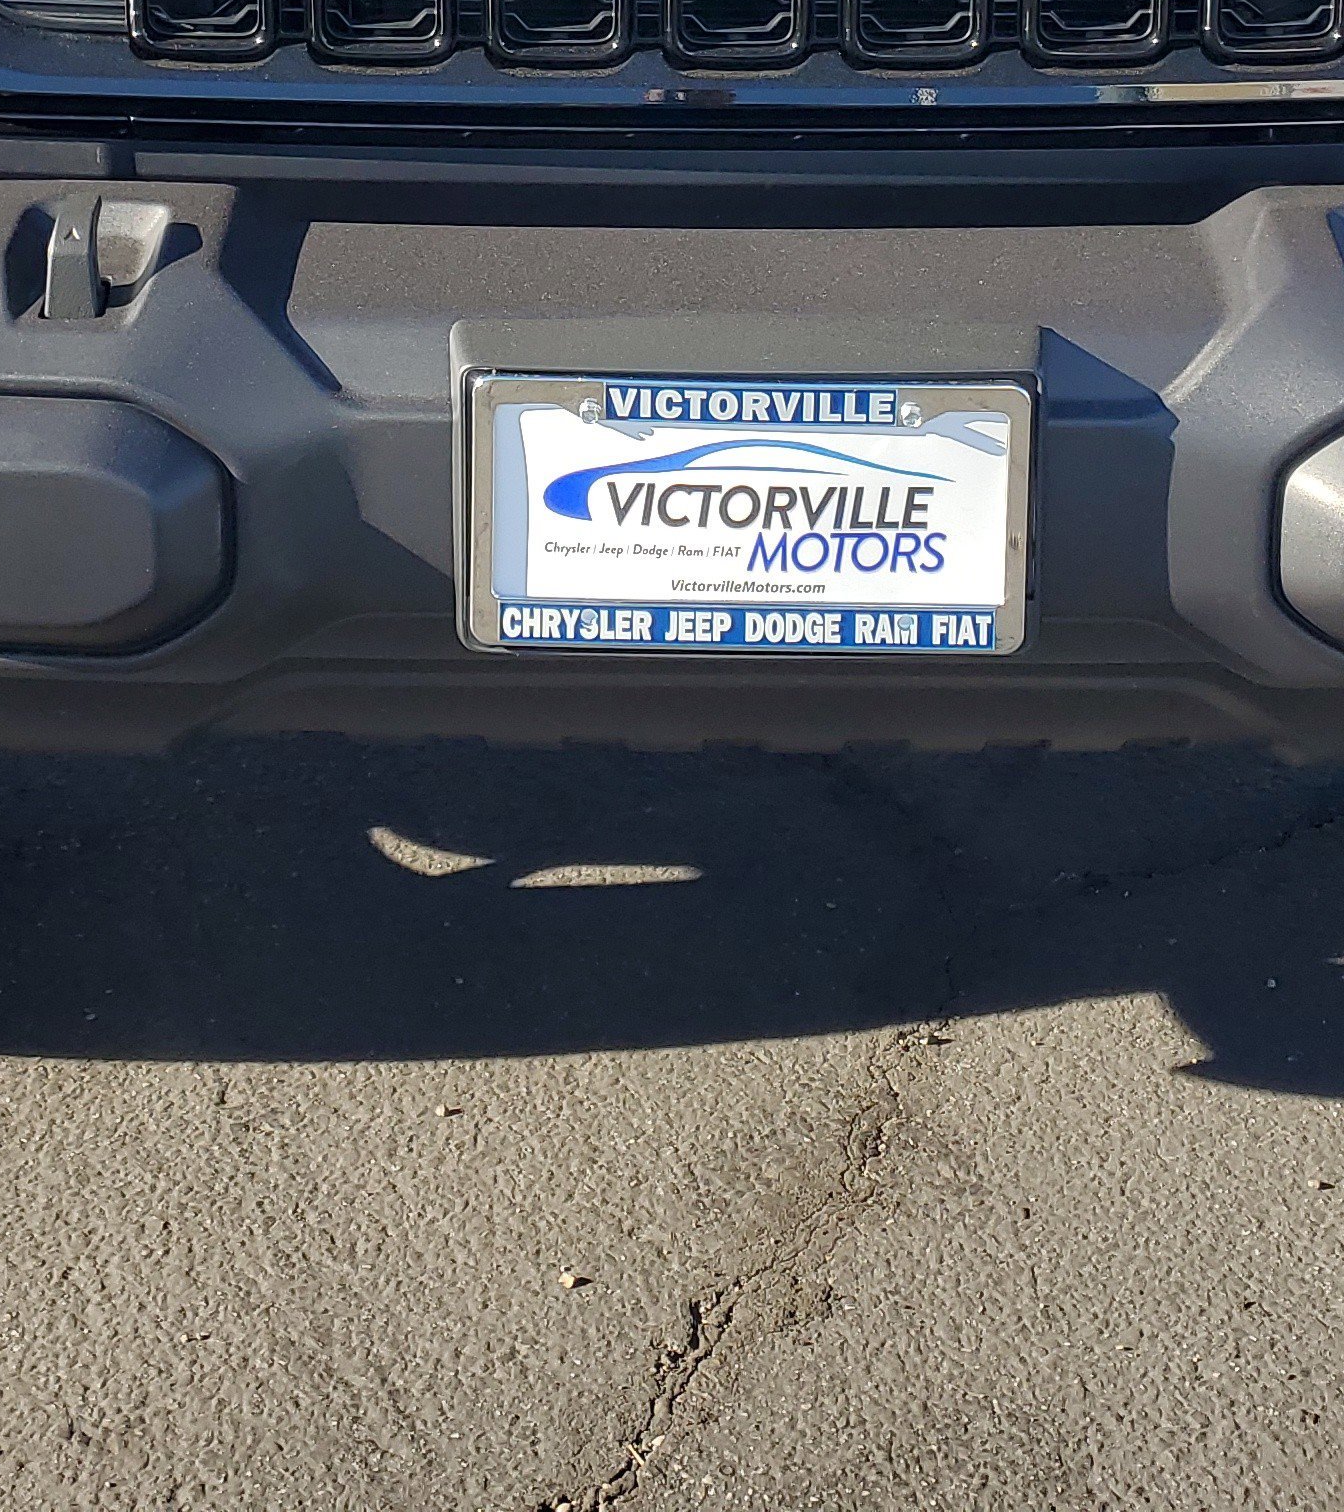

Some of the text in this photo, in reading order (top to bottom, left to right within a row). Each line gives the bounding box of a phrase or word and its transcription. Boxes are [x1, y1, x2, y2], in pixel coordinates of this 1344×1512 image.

[607, 387, 895, 423] VICTORVILLE
[606, 481, 935, 530] VICTORVILLE
[544, 541, 742, 559] Chrysler Jeep Dodge Ram FIAT
[746, 531, 948, 574] MOTORS
[671, 579, 826, 595] VictorvilleMotors.com
[664, 610, 732, 642] JEEP
[744, 611, 842, 644] DODGE
[854, 613, 918, 645] RAM
[932, 614, 992, 646] FIAT
